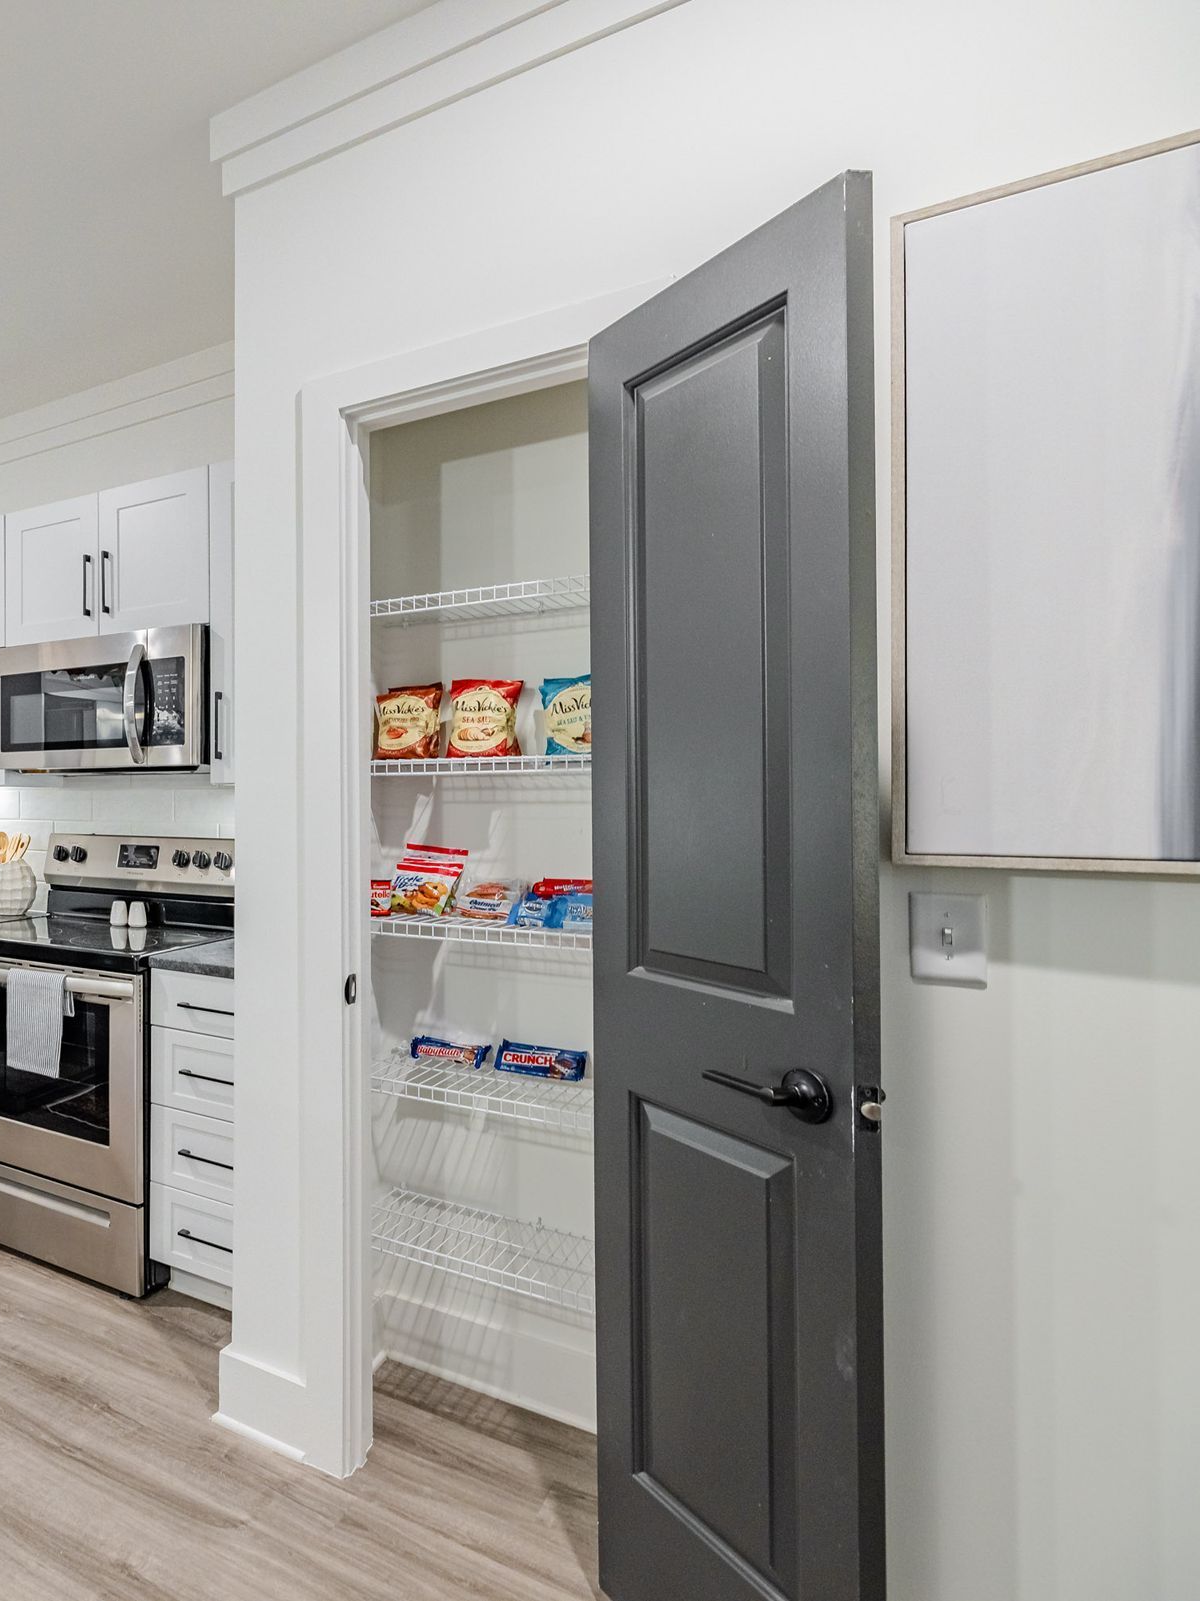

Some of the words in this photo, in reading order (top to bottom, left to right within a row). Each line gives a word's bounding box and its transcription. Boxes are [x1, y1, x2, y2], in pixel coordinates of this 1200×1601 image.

[396, 702, 425, 715] Vickie's
[476, 697, 507, 714] Vickie's
[551, 701, 576, 717] Miss
[469, 899, 503, 908] Oatmeal
[503, 1052, 553, 1066] CRUNCH
